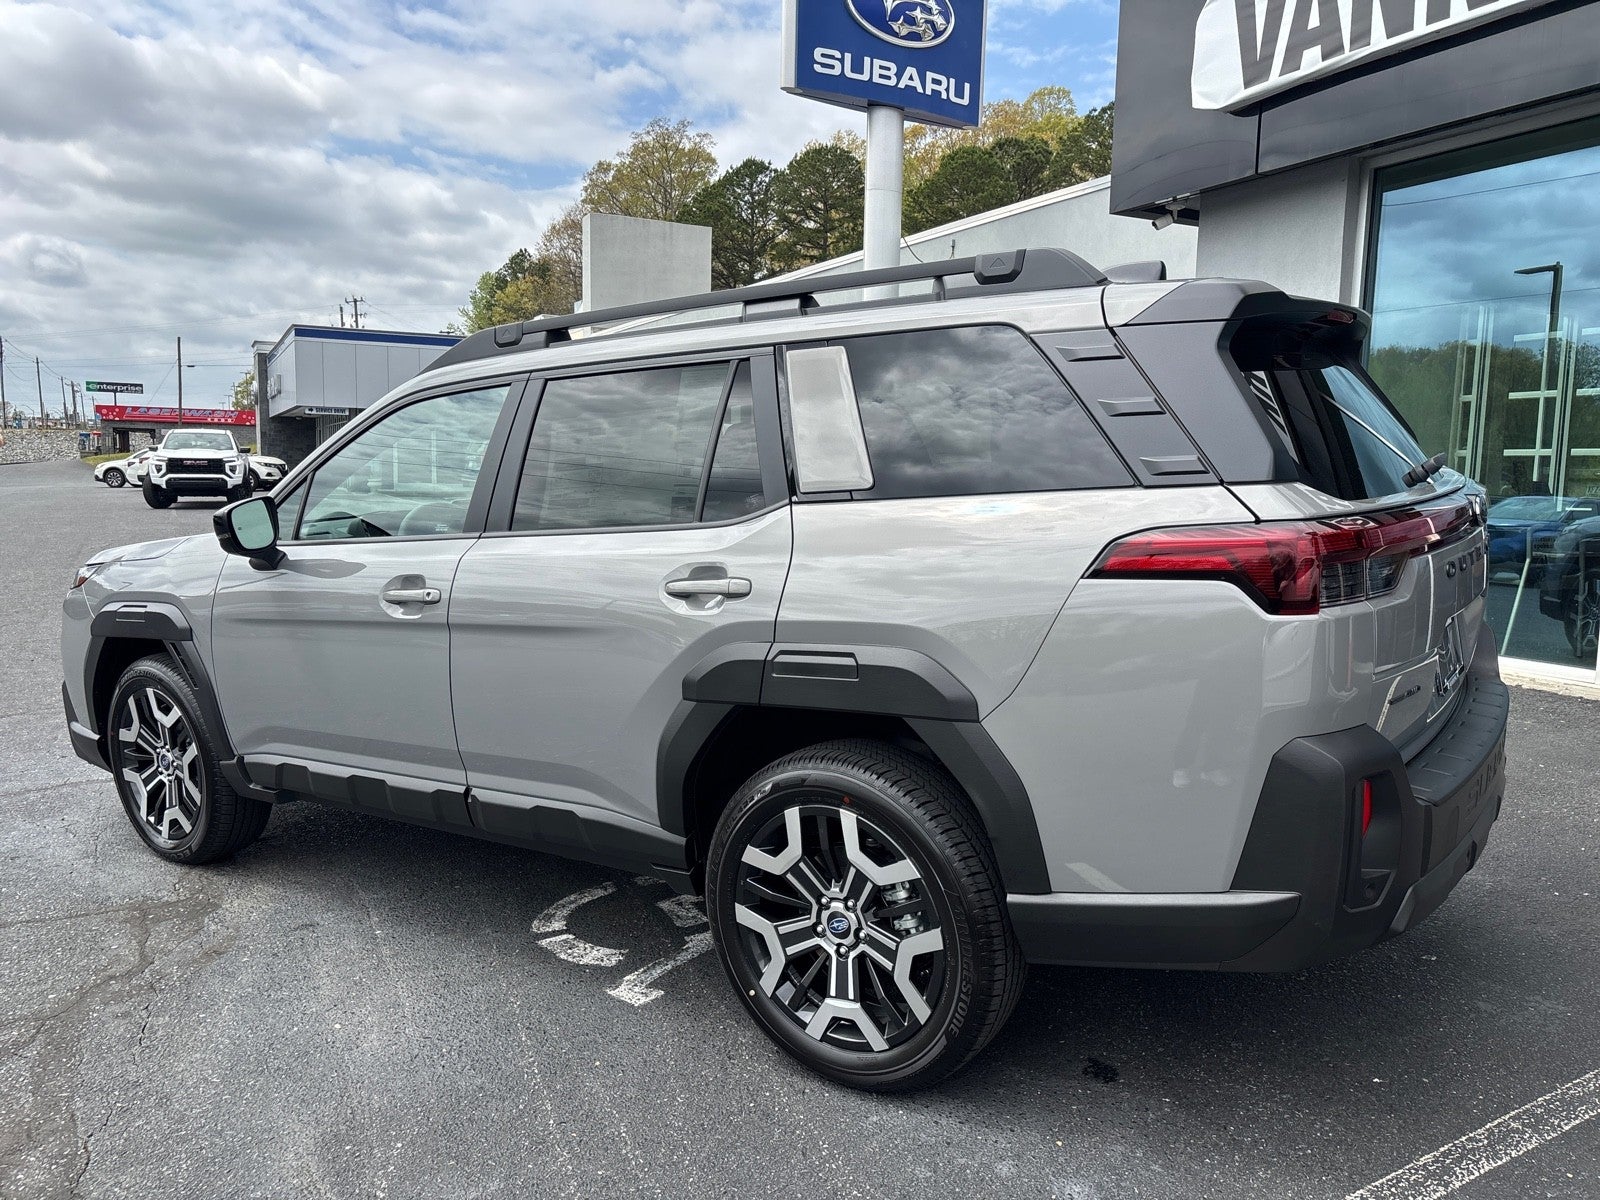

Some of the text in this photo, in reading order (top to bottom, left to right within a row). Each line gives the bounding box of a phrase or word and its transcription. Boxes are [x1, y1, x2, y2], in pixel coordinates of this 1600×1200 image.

[1234, 0, 1502, 90] VA
[813, 46, 970, 106] SUBARU
[87, 383, 143, 392] enterprise
[125, 407, 238, 417] LASERWASH
[950, 903, 975, 1039] BRIDGESTONE
